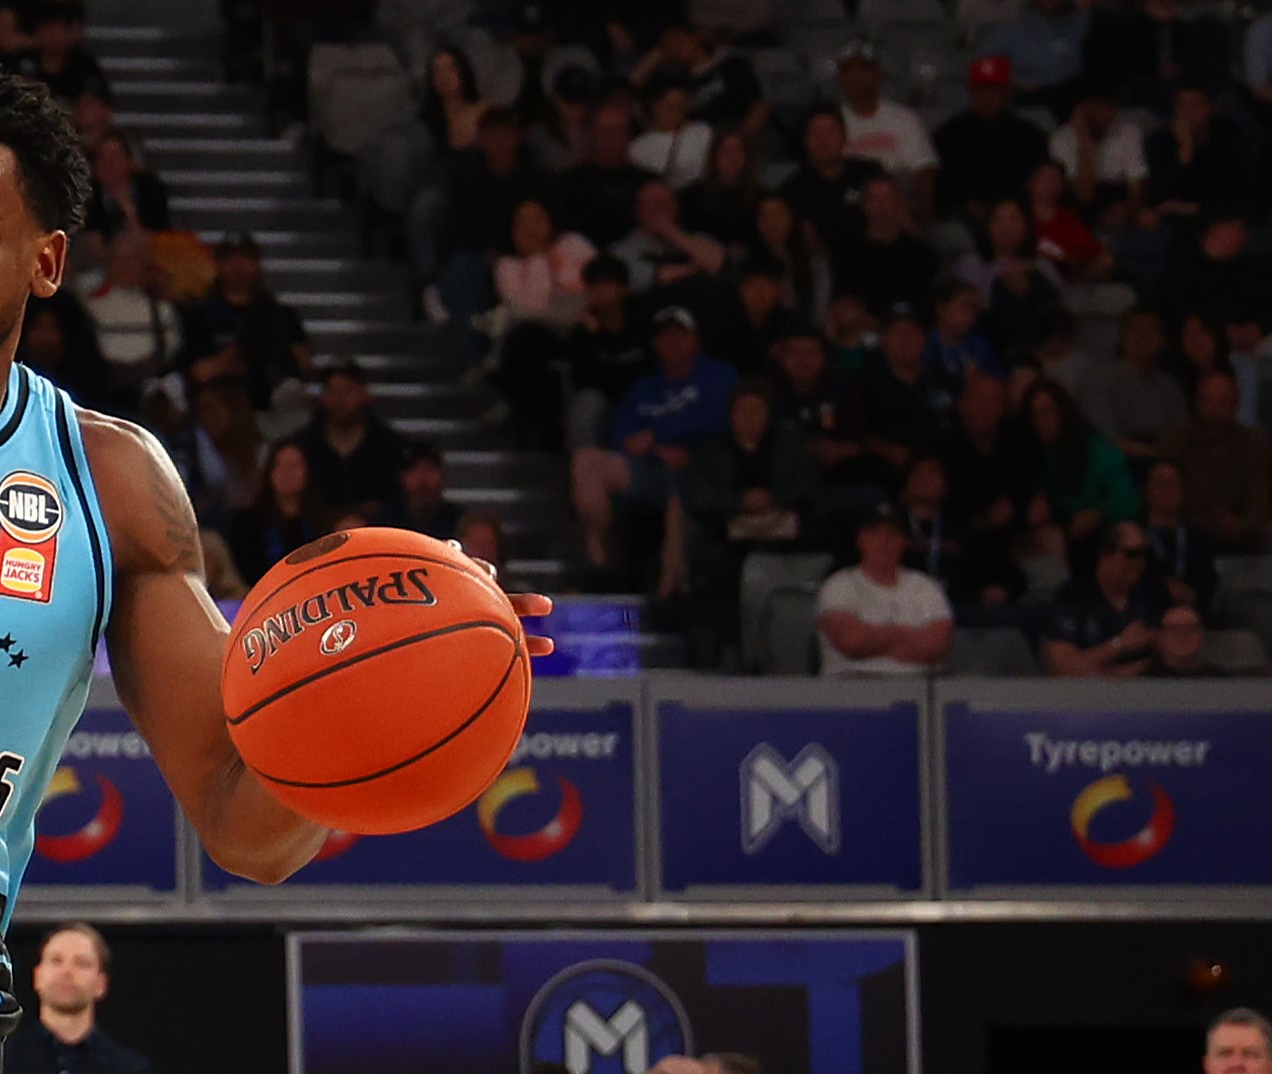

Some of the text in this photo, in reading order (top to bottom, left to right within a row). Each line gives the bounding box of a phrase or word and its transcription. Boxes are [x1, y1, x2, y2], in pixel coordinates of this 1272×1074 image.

[8, 489, 49, 524] NBL
[5, 559, 41, 571] HUNGRY
[243, 567, 438, 675] SPALDING
[1024, 731, 1212, 774] Tyrepower
